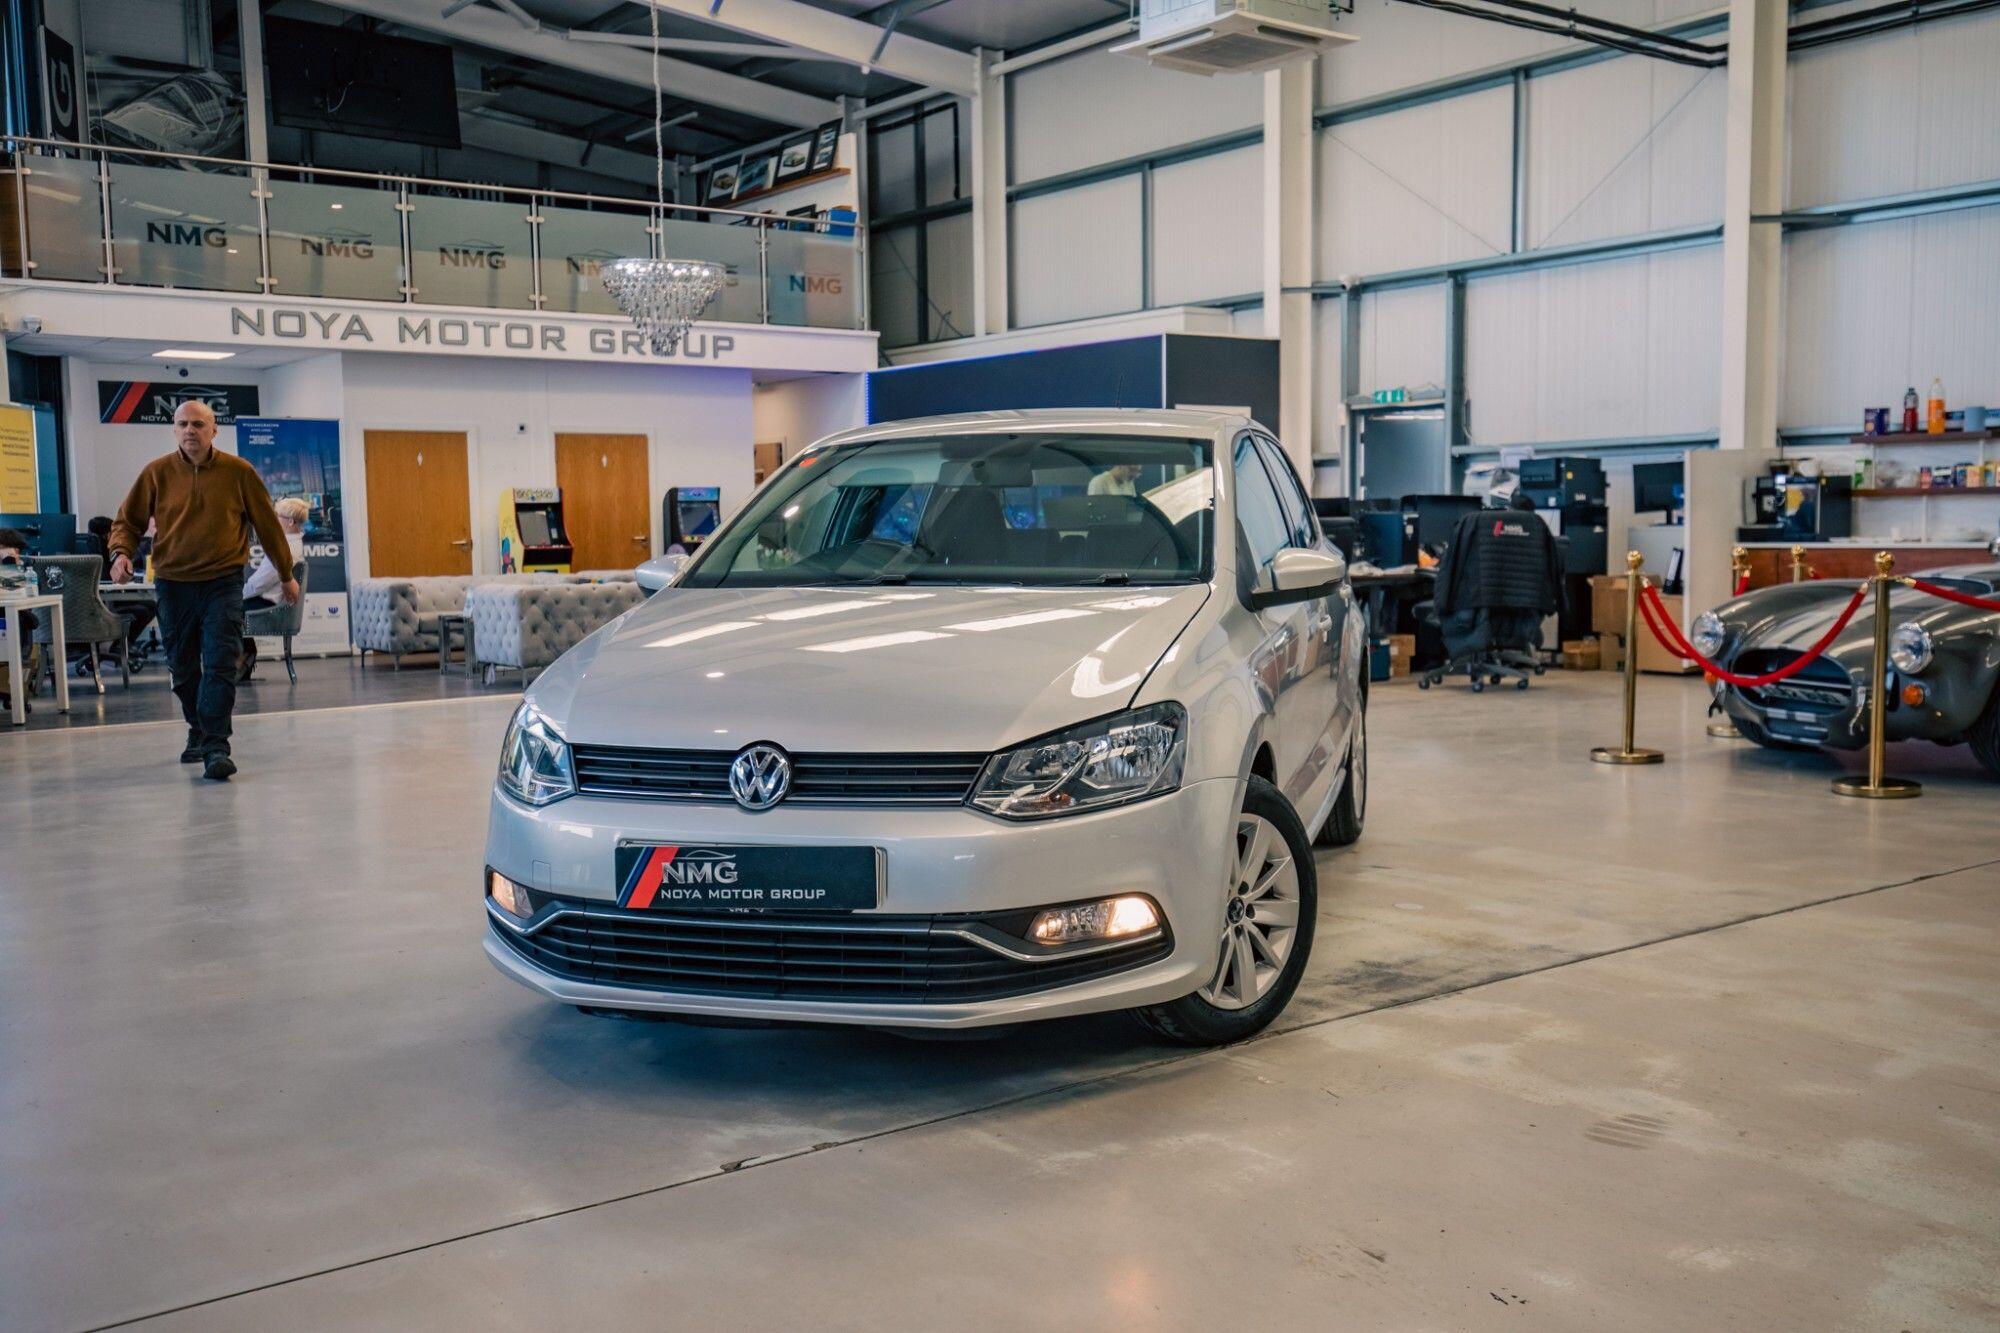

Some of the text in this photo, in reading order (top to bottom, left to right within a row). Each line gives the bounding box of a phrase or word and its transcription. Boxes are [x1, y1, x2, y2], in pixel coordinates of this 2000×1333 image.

[147, 222, 227, 248] NMG
[301, 238, 374, 259] NMG
[438, 247, 506, 269] NMG
[566, 256, 601, 276] NM
[789, 274, 842, 295] NMG
[231, 307, 373, 341] NOYA
[398, 316, 567, 351] MOTOR
[141, 414, 168, 423] NOYA
[661, 862, 739, 884] NMG
[661, 889, 826, 899] NOYA MOTOR GROUP
